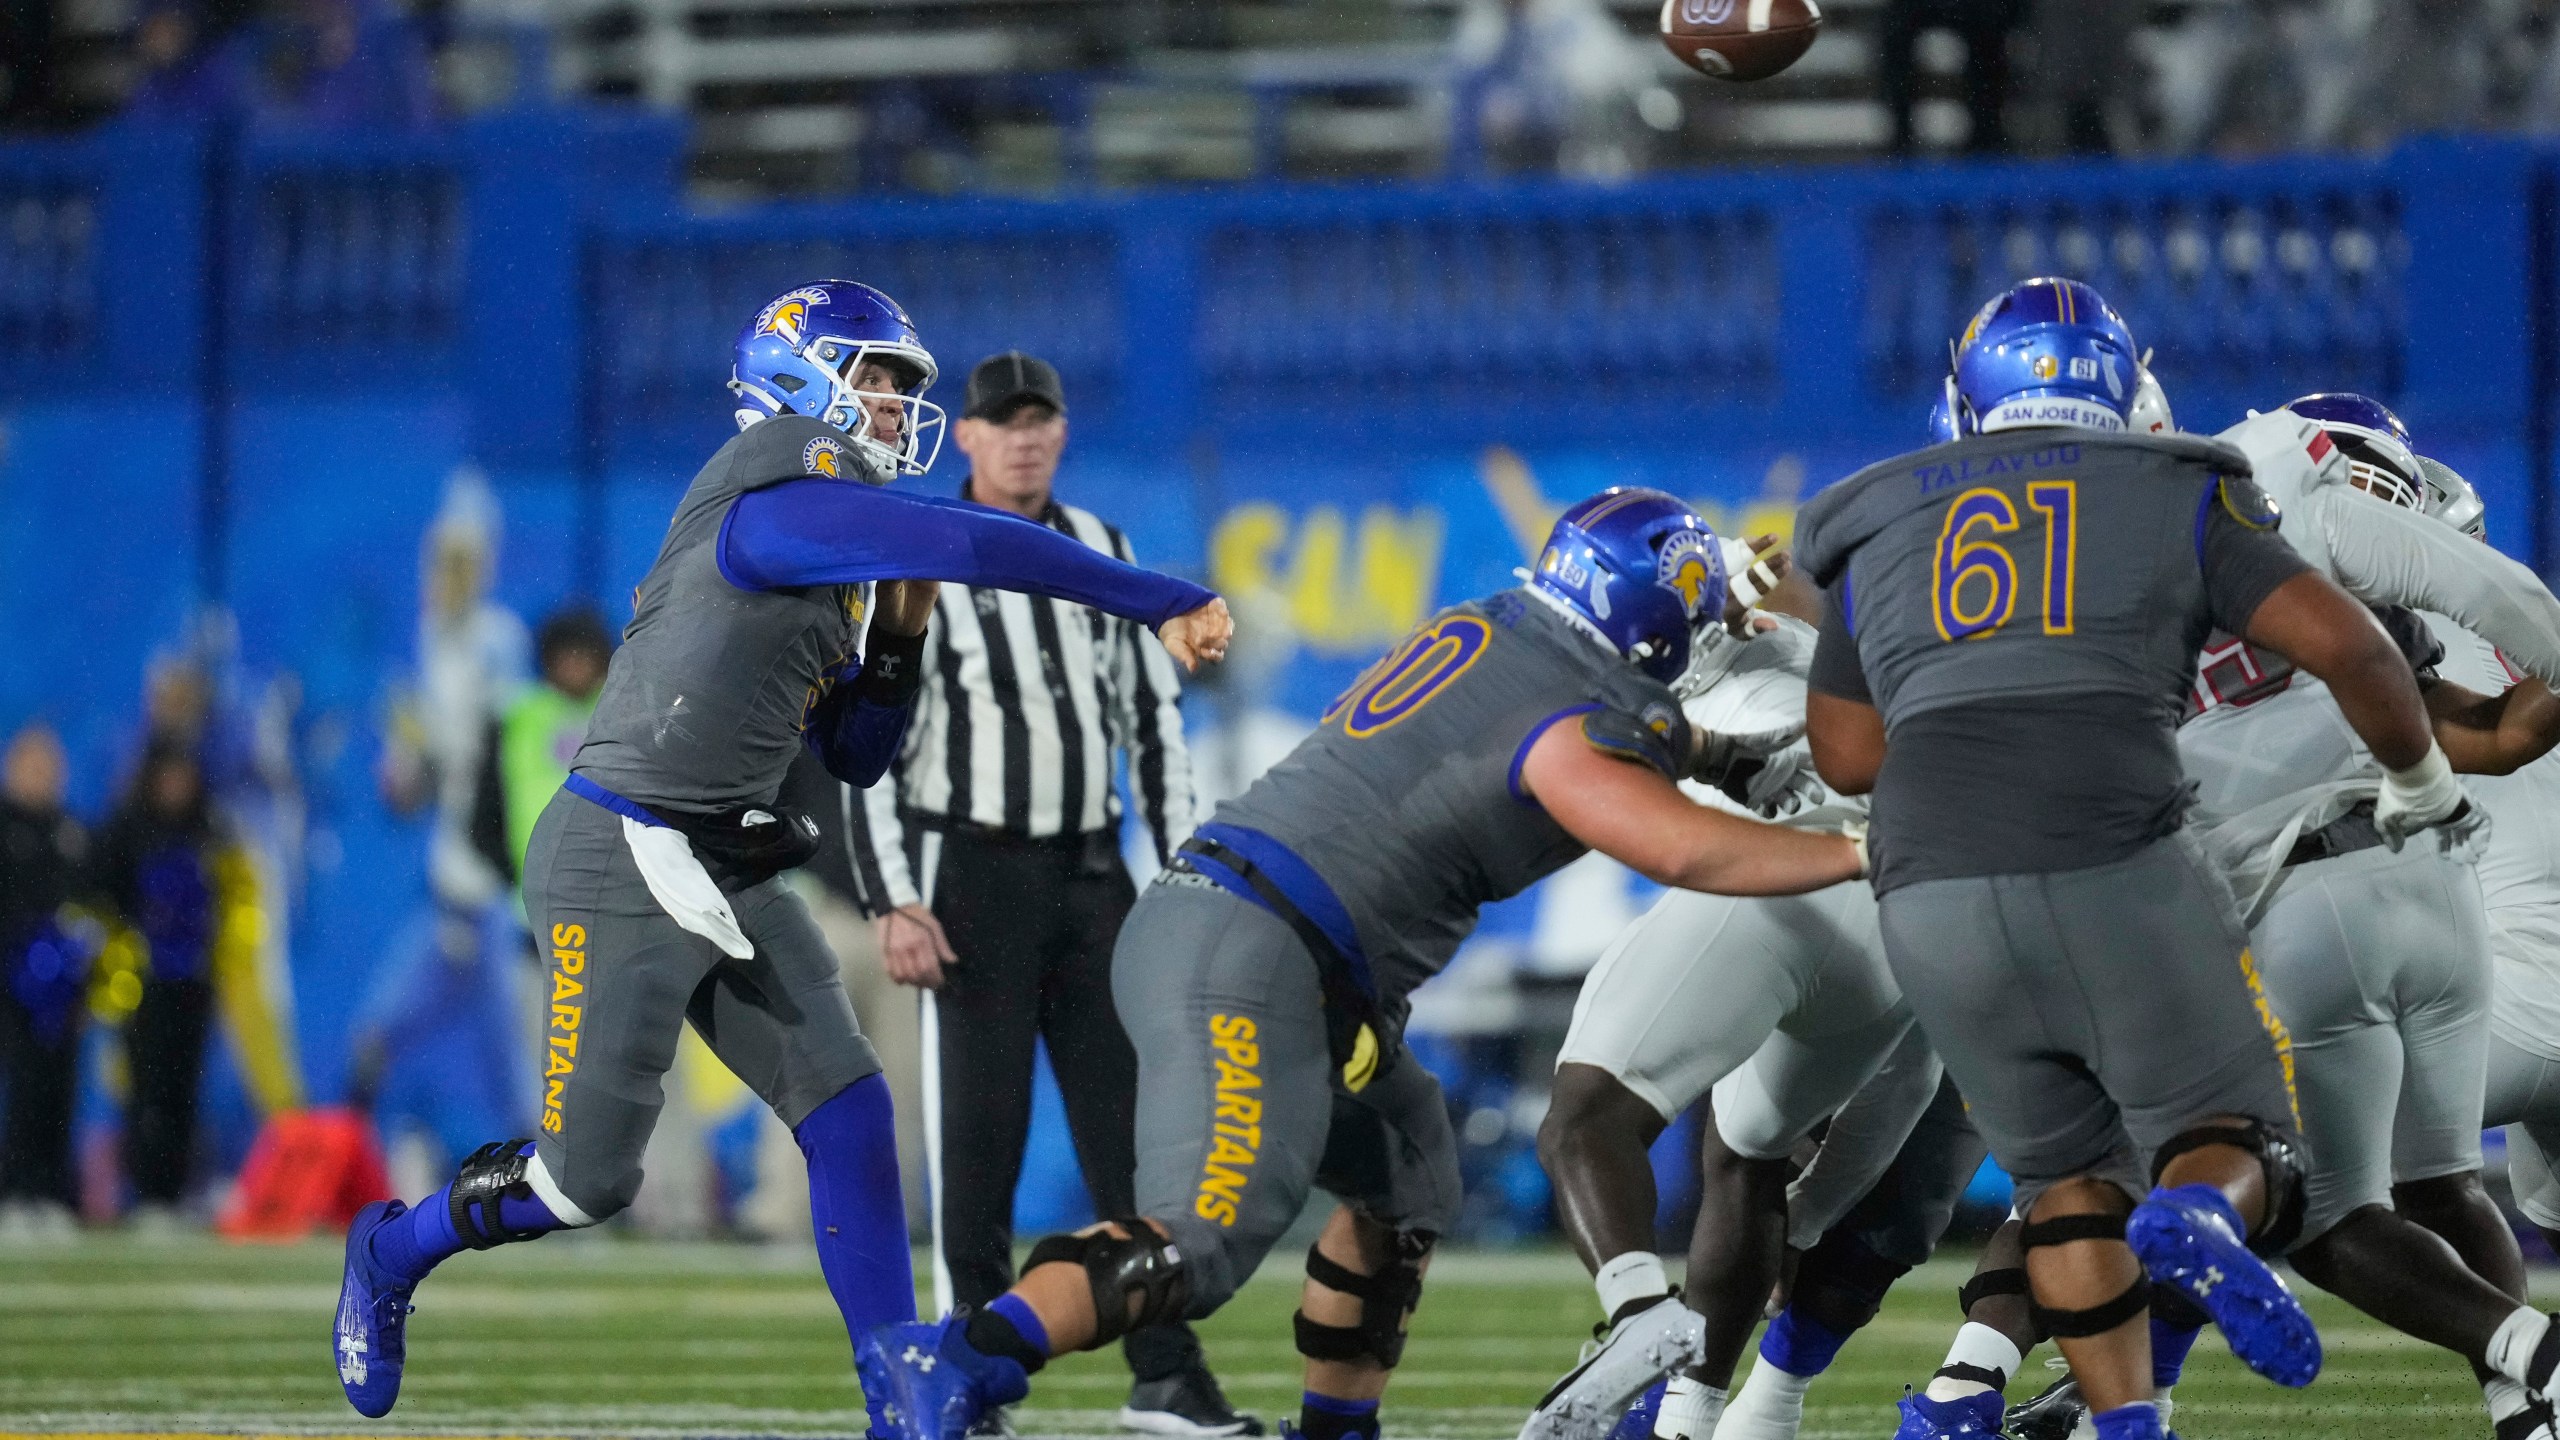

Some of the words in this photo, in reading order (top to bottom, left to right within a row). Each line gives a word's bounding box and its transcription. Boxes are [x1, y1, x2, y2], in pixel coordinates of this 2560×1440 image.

[2002, 407, 2033, 422] SAN
[2037, 402, 2077, 420] JOSÉ
[2082, 408, 2119, 431] STATE
[2076, 359, 2092, 378] 61
[1931, 480, 2078, 642] 61
[541, 922, 587, 1134] SPARTANS
[1194, 1013, 1263, 1227] SPARTANS
